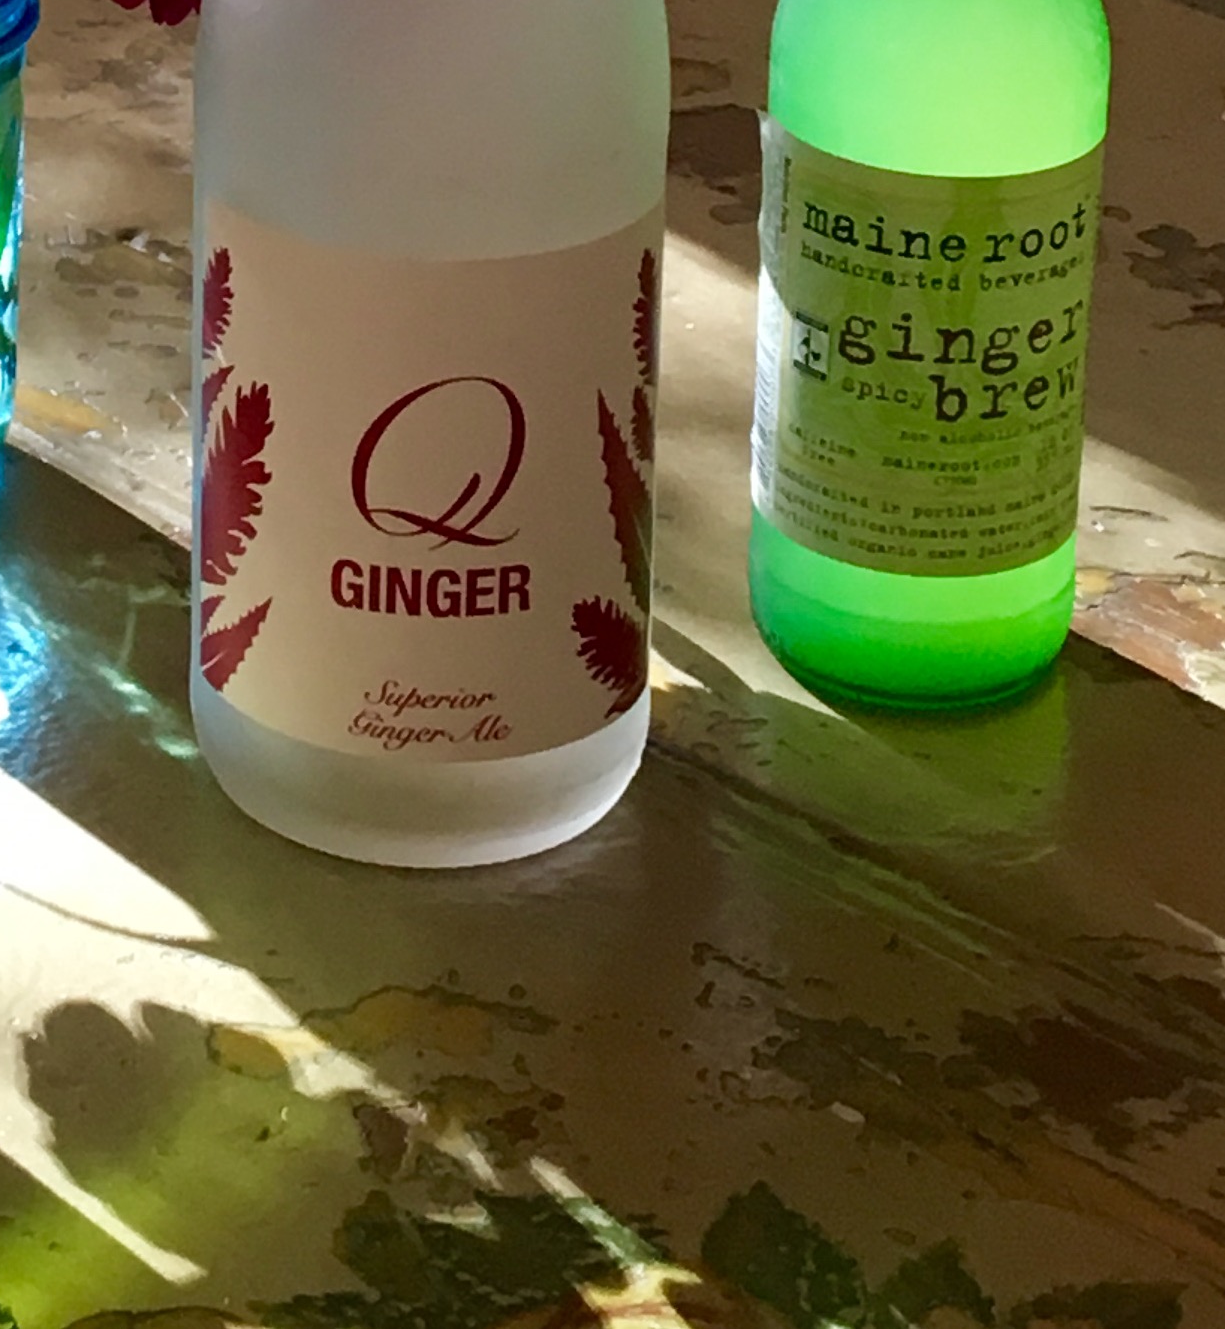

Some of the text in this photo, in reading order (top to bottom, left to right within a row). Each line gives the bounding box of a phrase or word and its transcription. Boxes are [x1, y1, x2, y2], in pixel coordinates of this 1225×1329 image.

[803, 200, 1087, 263] maine root
[838, 298, 1084, 375] ginger
[841, 374, 927, 409] spicy
[352, 377, 526, 550] Q
[330, 559, 531, 618] GINGER
[363, 679, 497, 717] Superior
[347, 709, 513, 751] Ginger Ale
